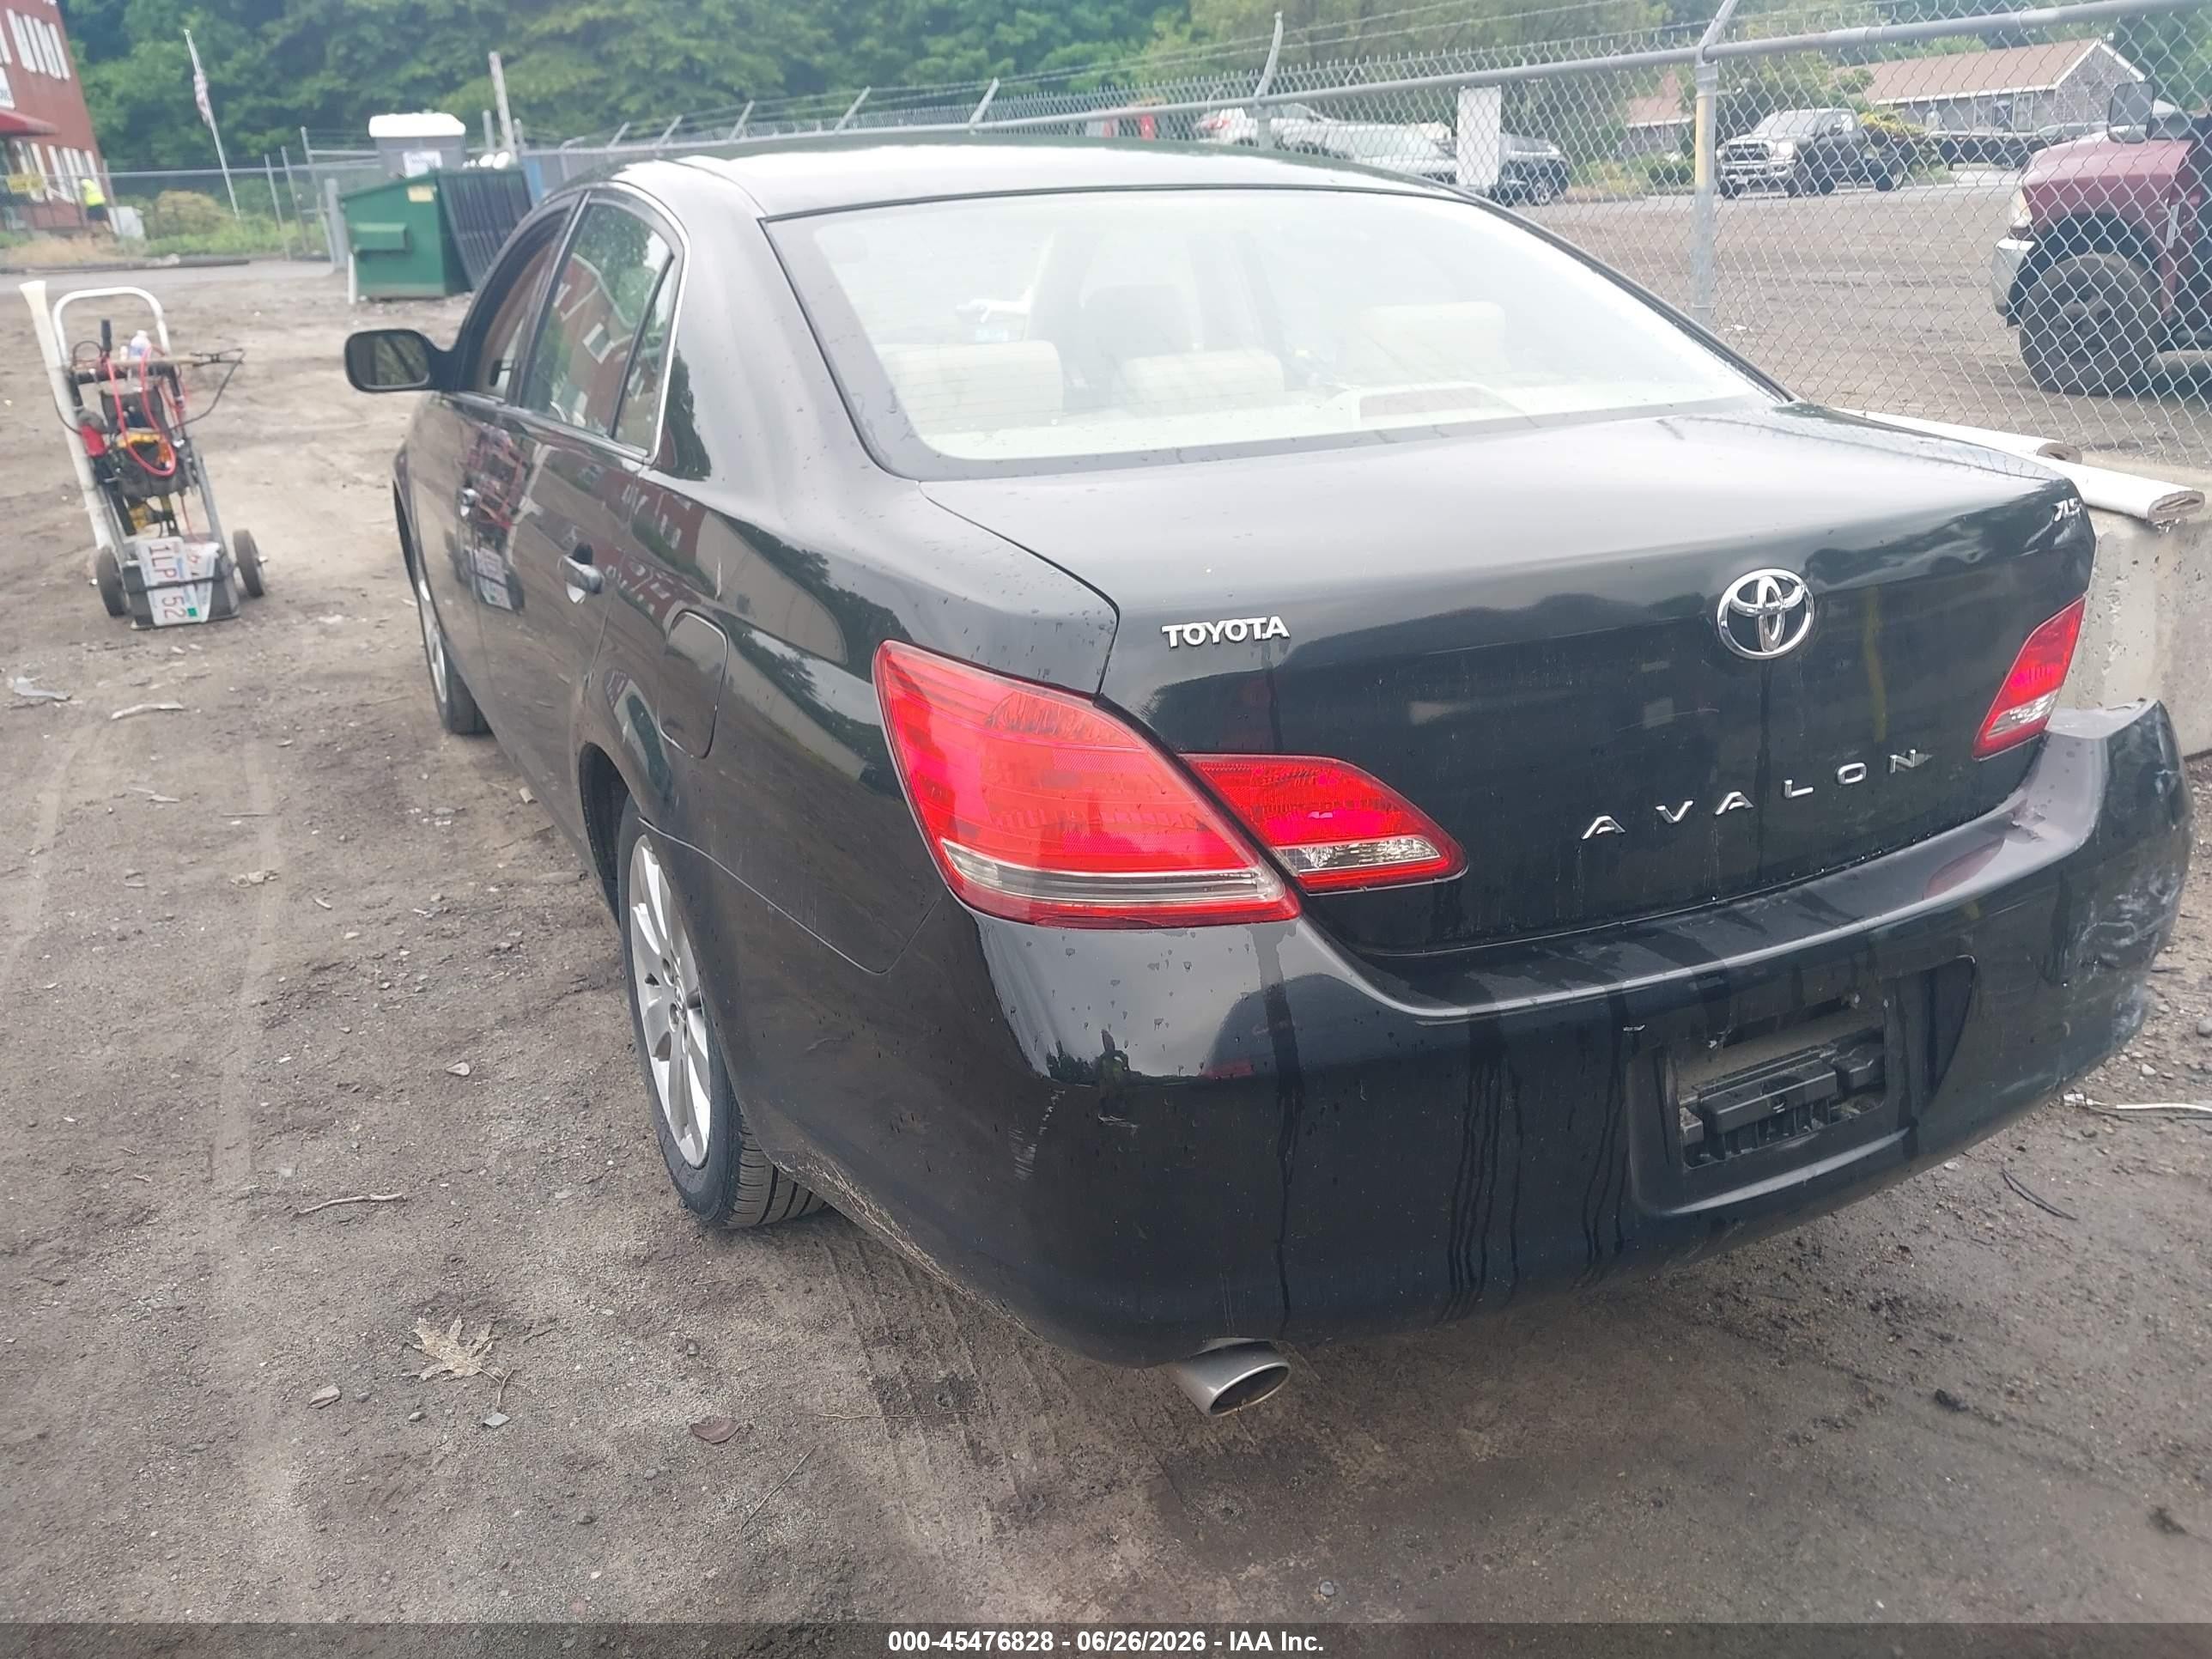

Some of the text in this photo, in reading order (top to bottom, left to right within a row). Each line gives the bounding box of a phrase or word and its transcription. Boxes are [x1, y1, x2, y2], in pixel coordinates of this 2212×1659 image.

[161, 595, 186, 618] 52
[1161, 616, 1291, 647] TOYOTA
[1581, 749, 1917, 841] AVALON
